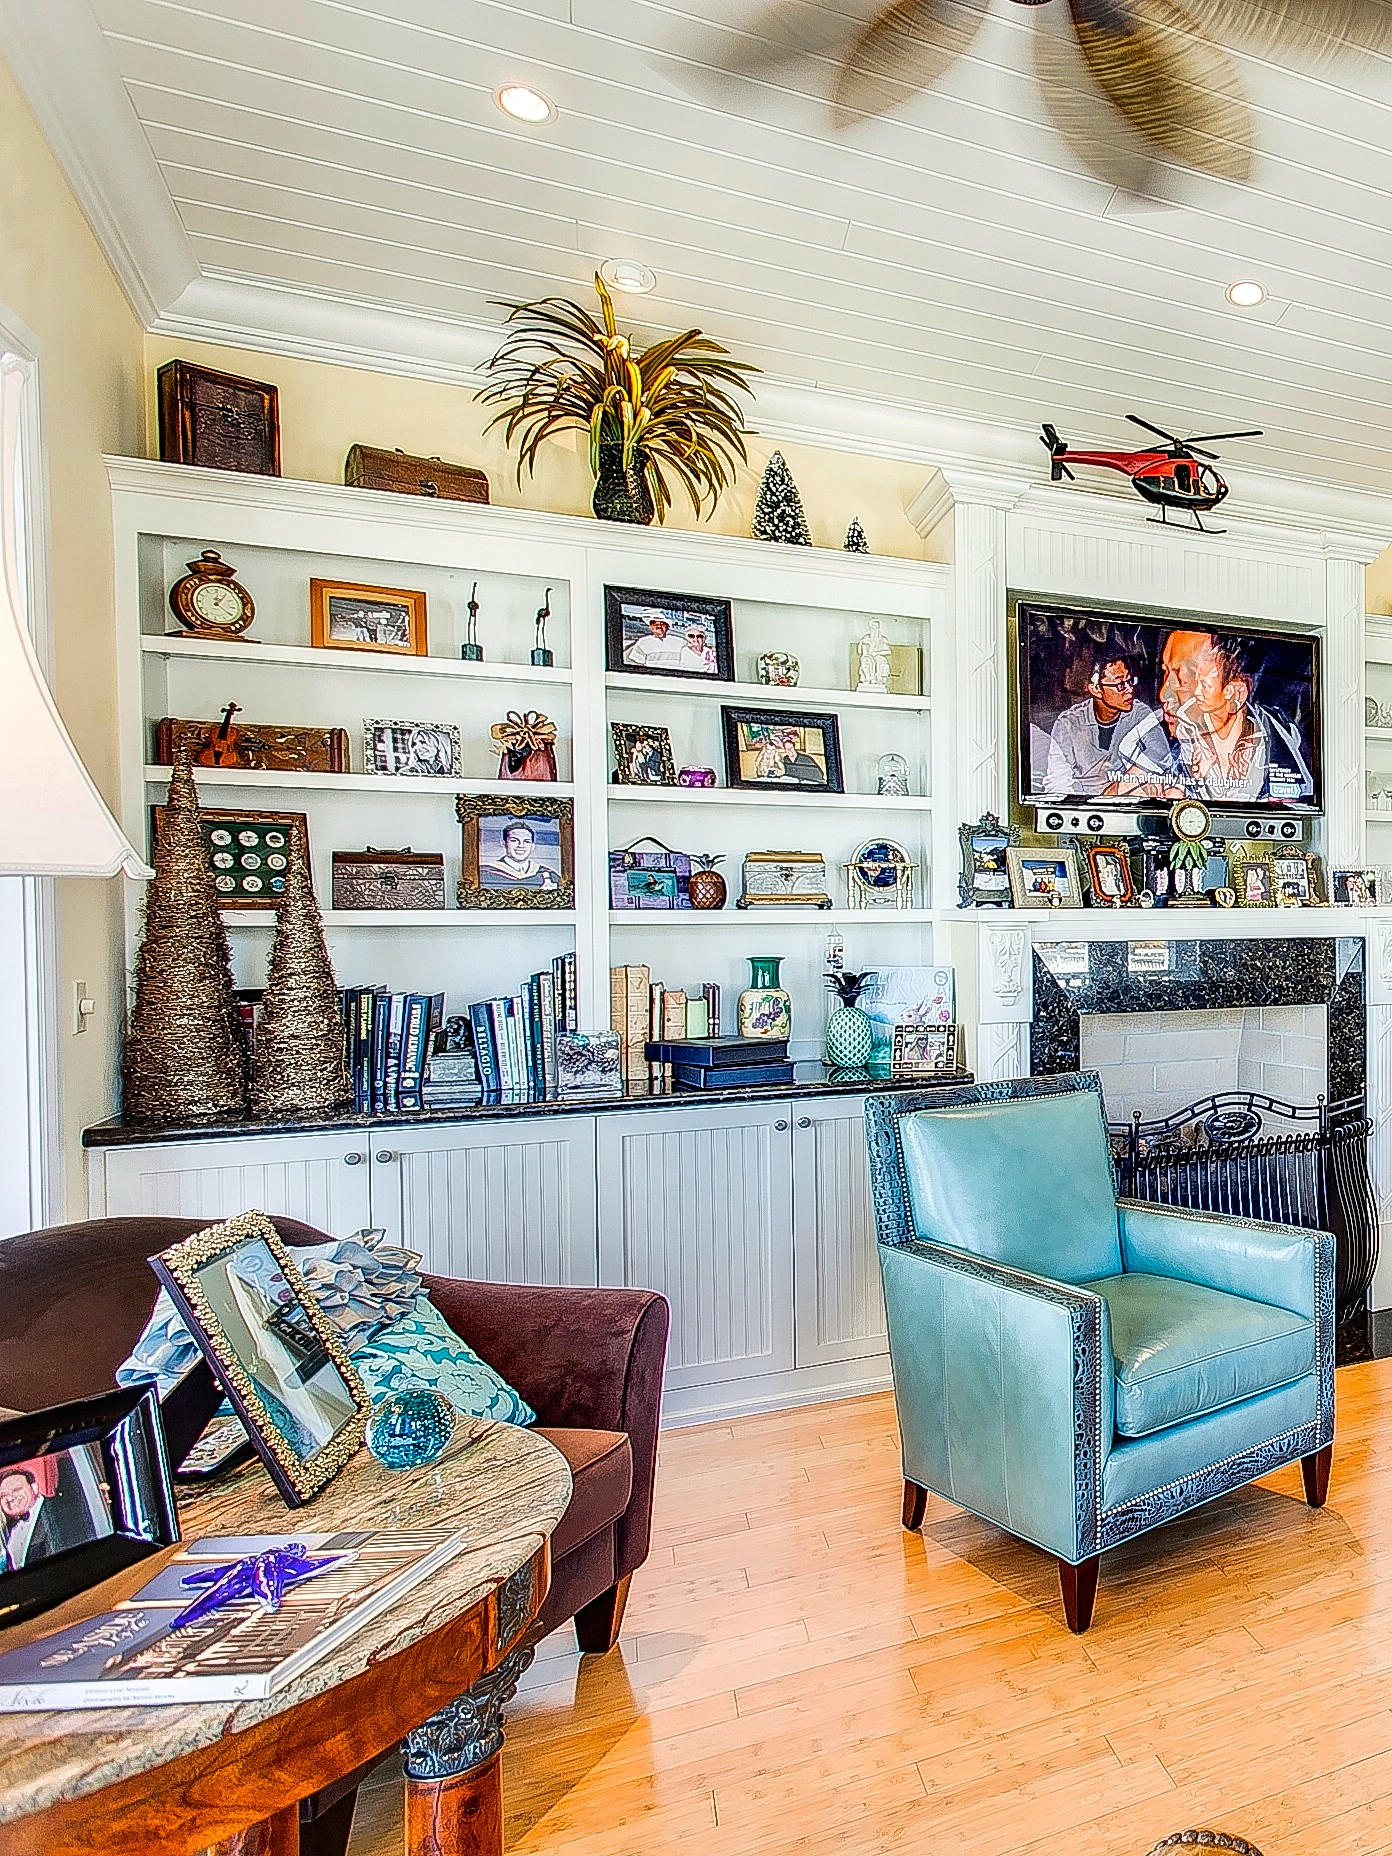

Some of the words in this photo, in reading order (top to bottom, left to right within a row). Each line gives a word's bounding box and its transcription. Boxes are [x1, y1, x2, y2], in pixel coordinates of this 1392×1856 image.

[1106, 769, 1136, 784] When
[1139, 774, 1146, 783] a
[1147, 772, 1178, 787] family
[1179, 774, 1197, 786] has
[1198, 776, 1205, 786] a
[1205, 776, 1249, 789] daughter
[476, 1025, 493, 1075] BELLAGIO
